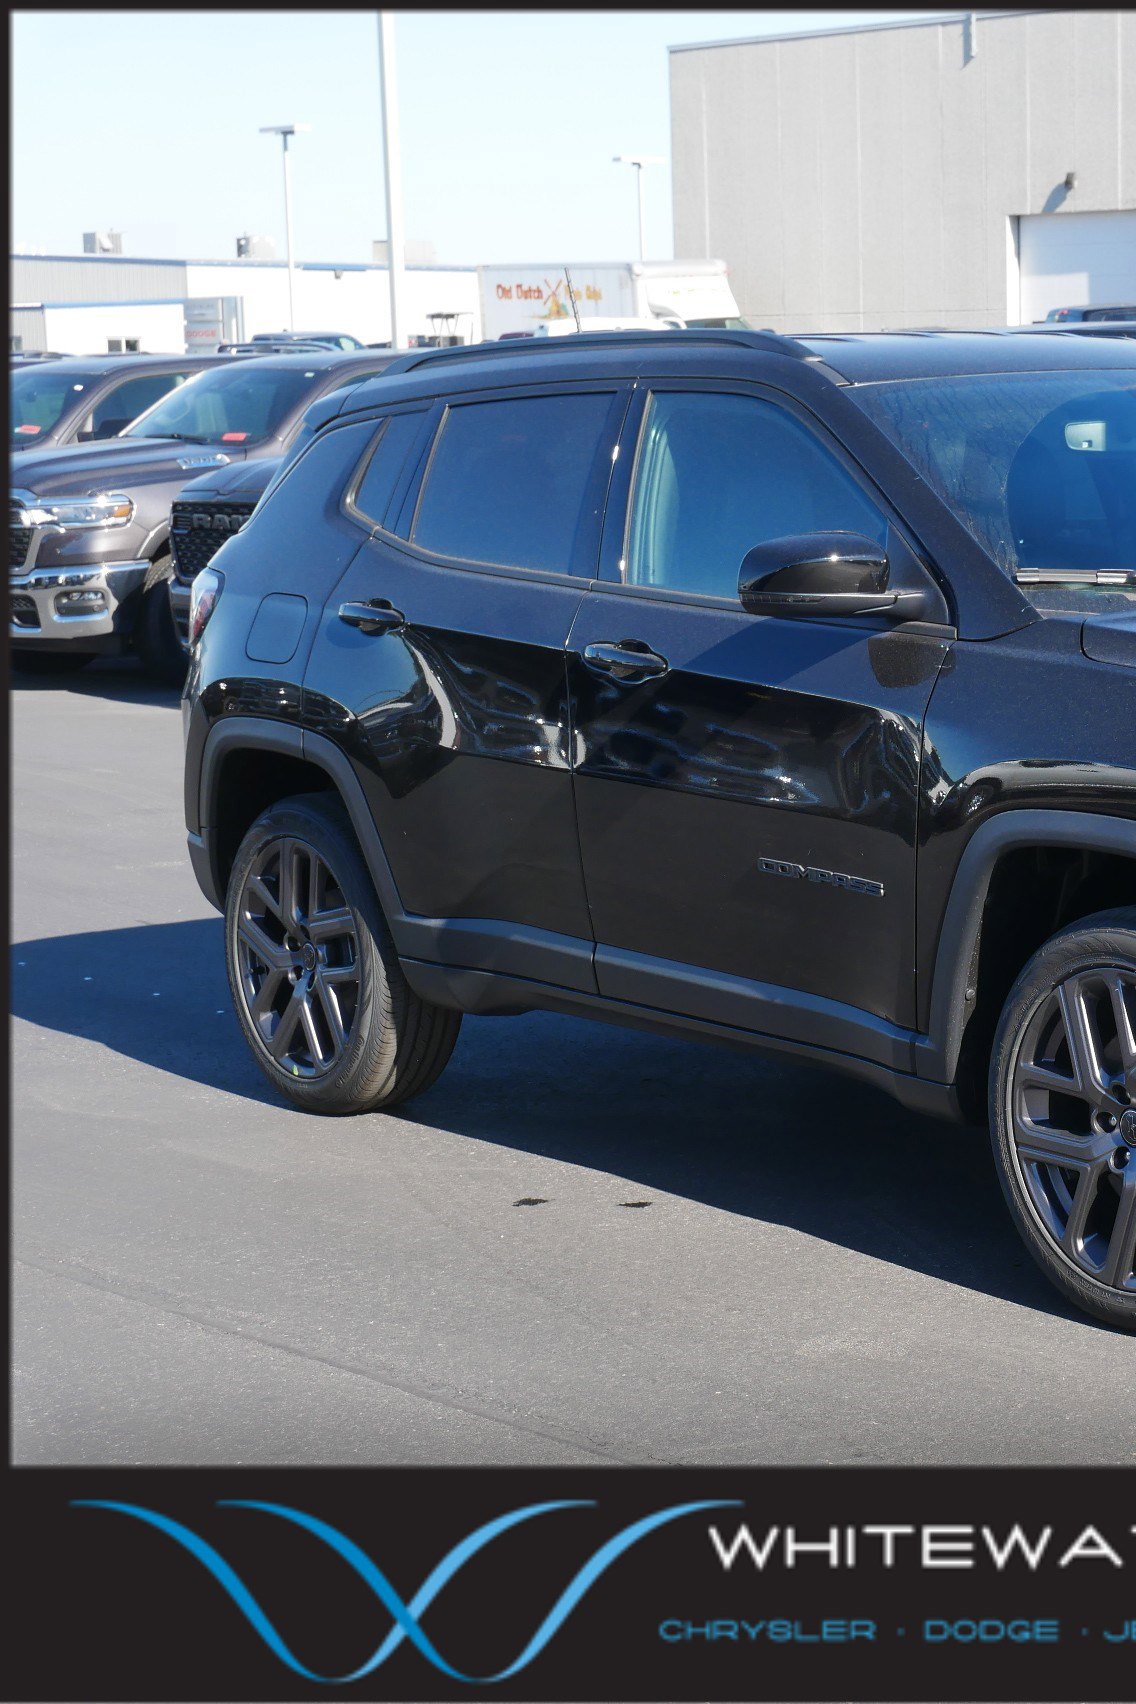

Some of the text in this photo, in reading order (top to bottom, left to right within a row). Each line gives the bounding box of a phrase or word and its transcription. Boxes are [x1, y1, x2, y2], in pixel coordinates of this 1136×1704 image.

[496, 284, 543, 299] Old Dutch
[758, 857, 884, 897] COMPASS
